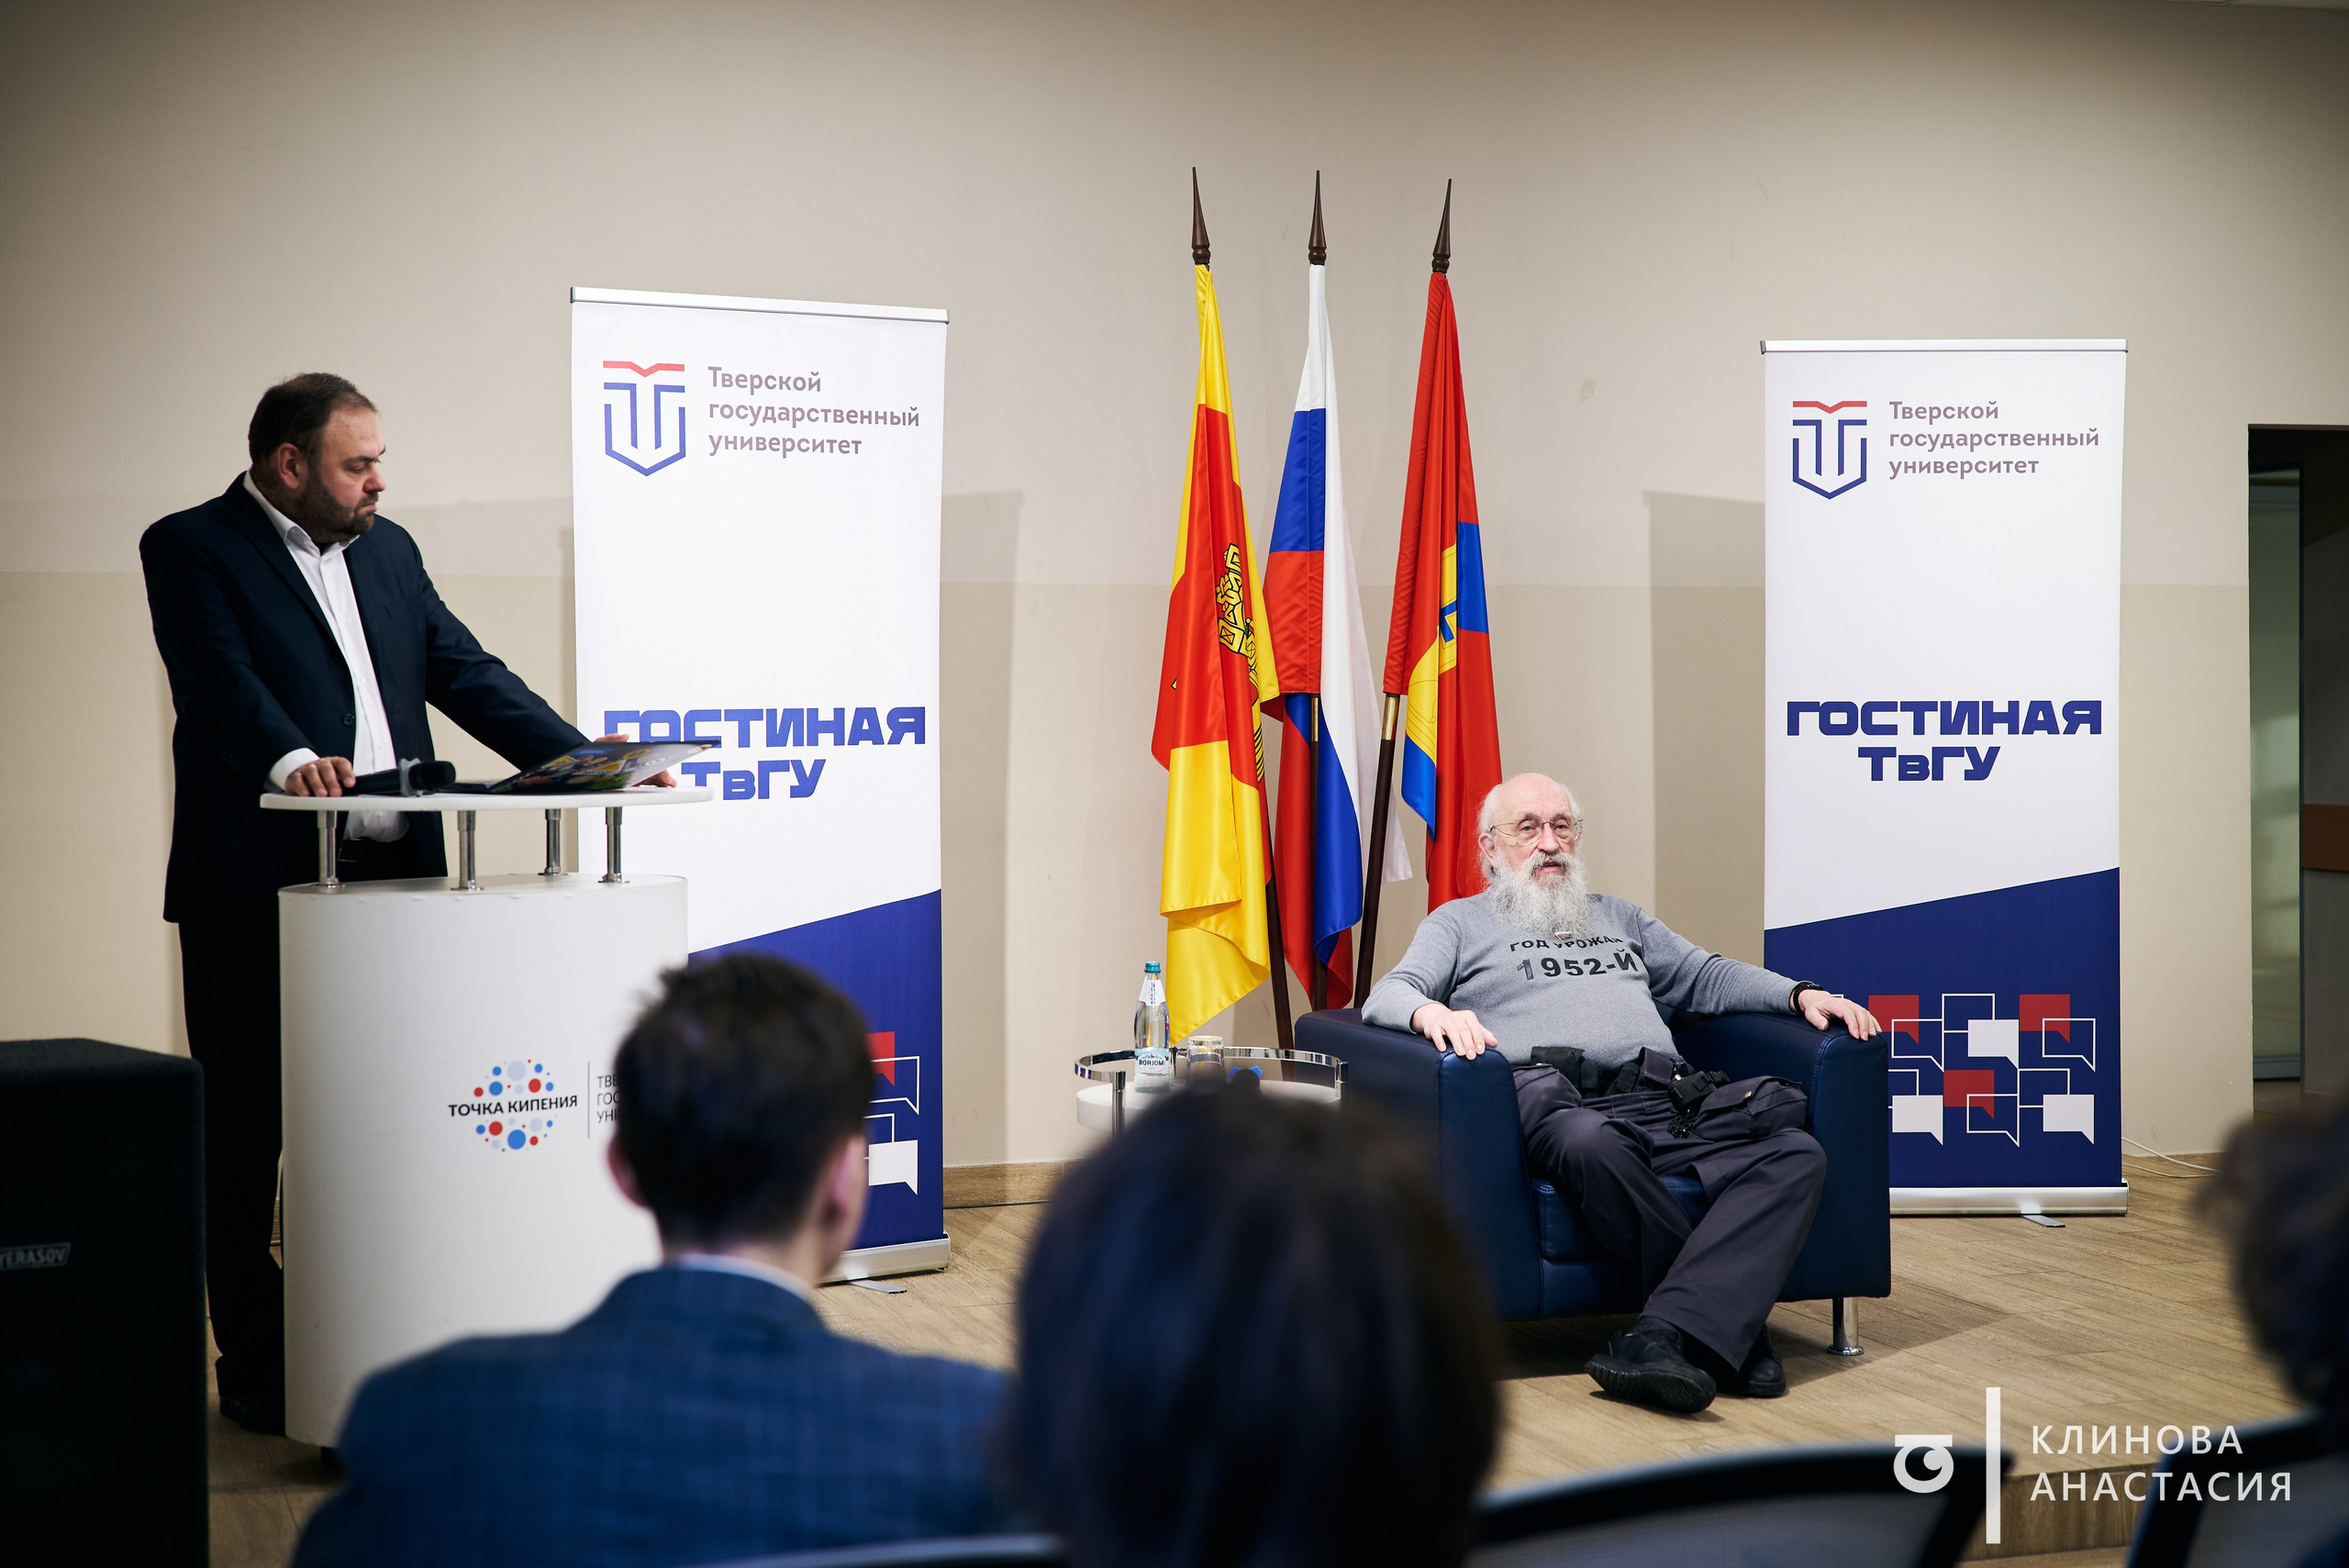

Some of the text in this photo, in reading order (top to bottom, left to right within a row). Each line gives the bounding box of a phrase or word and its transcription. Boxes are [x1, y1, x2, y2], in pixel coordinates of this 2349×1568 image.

[707, 366, 821, 395] Тверской
[708, 403, 919, 428] государственный
[1888, 400, 1999, 426] Тверской
[707, 434, 863, 459] университет
[1889, 428, 2099, 452] государственный
[1888, 460, 2040, 480] университет
[604, 706, 926, 749] ГОСТИНАЯ
[1787, 700, 2102, 736] ГОСТИНАЯ
[1857, 746, 2001, 782] ТвГУ
[681, 759, 827, 801] ТвГУ
[1509, 939, 1550, 952] ГОД
[1517, 948, 1640, 981] 1952-Й
[448, 1095, 578, 1118] ТОЧКА КИПЕНИЯ
